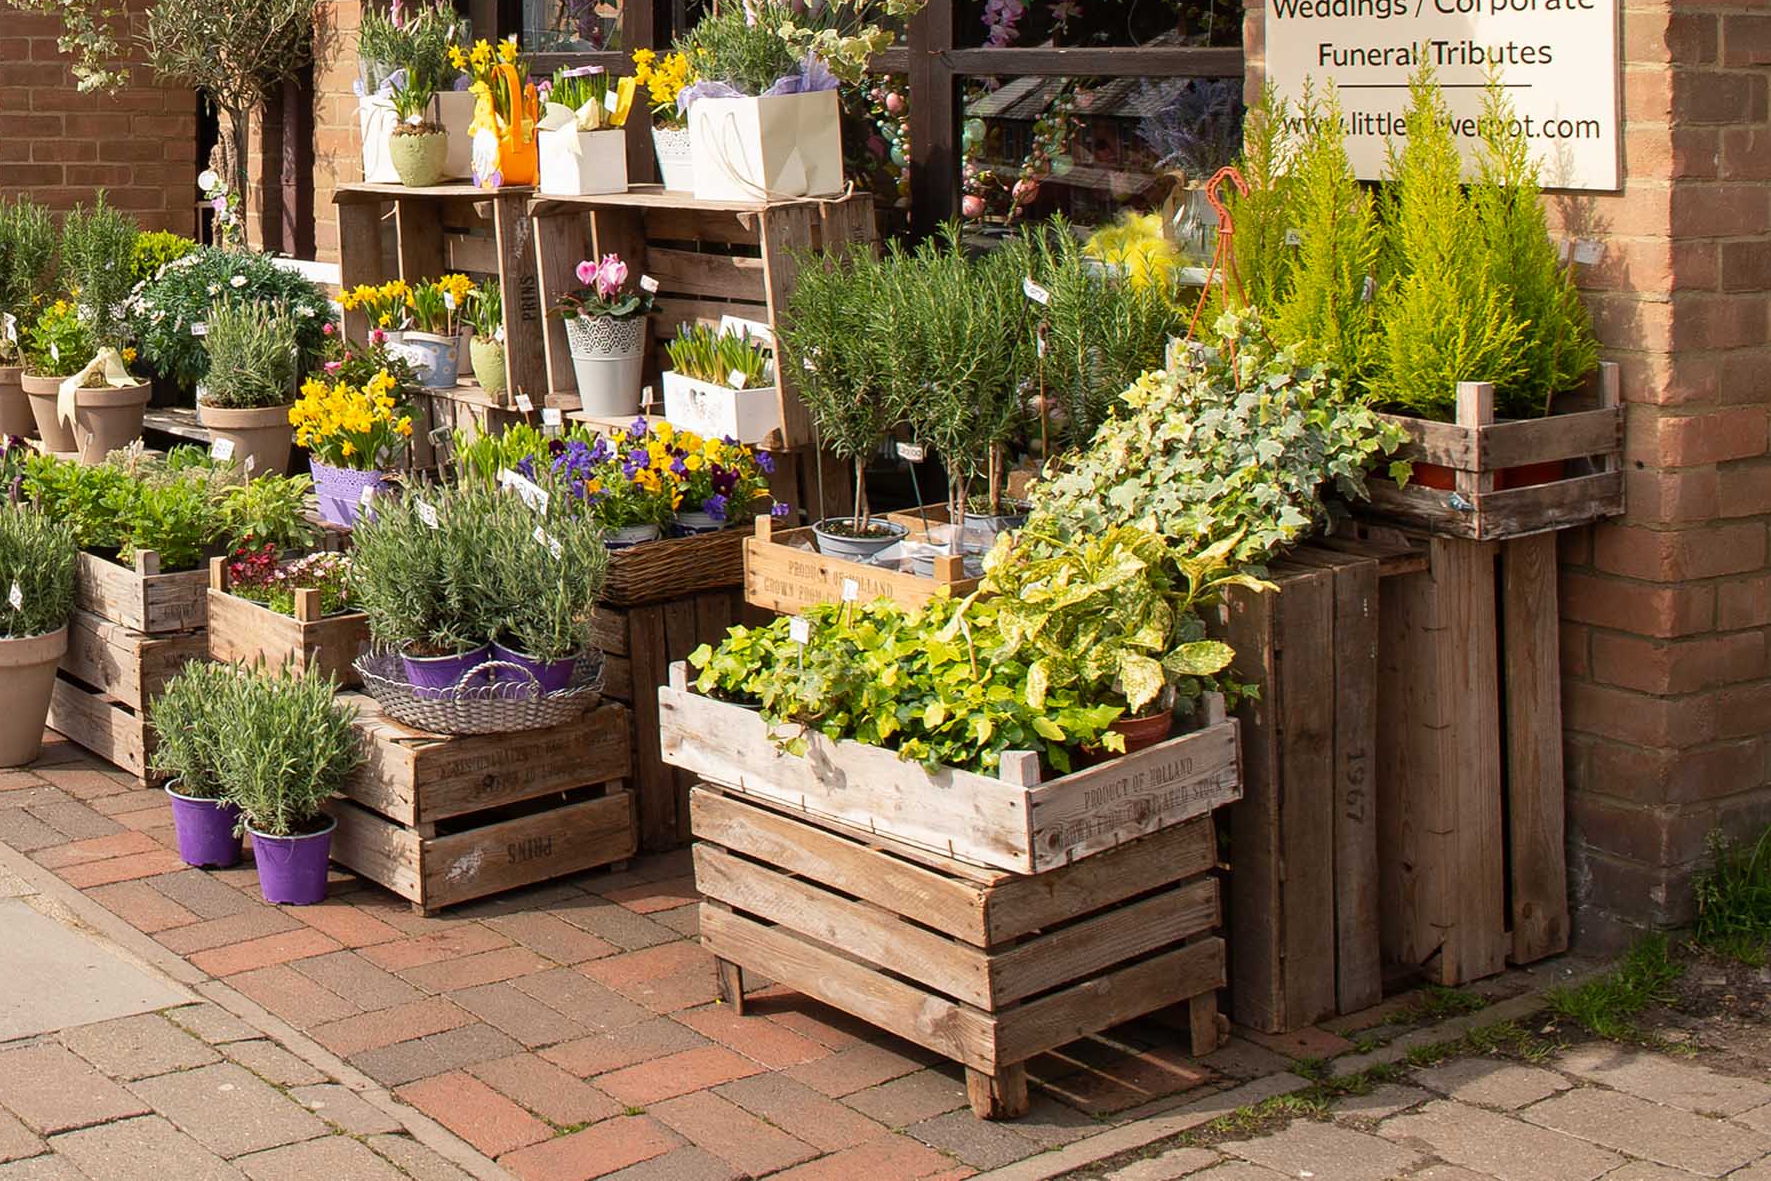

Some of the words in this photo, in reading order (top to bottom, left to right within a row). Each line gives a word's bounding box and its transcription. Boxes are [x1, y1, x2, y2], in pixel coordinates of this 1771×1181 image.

[1318, 41, 1418, 66] Funeral
[1431, 40, 1552, 65] Tributes
[1084, 778, 1128, 810] PRODUCT
[1149, 757, 1194, 787] HOLLAND
